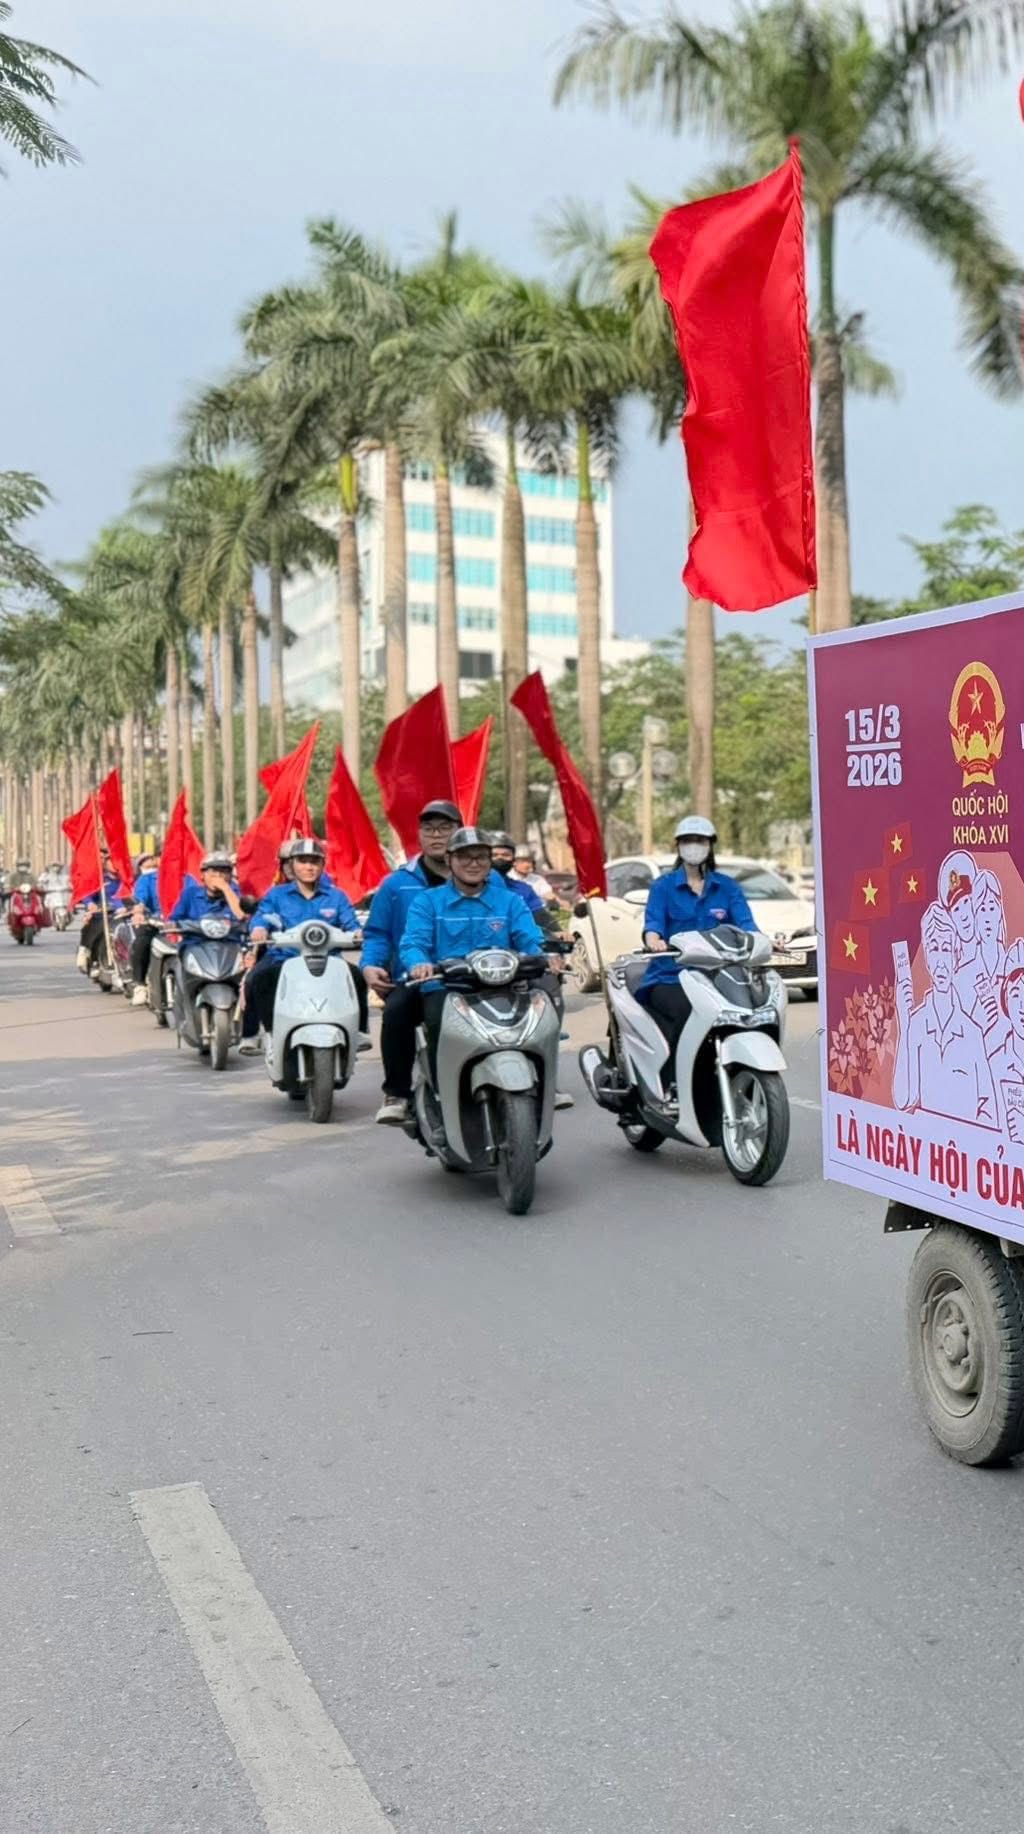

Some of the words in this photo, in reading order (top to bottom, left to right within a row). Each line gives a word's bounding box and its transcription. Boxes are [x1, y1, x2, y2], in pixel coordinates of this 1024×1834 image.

[845, 703, 901, 743] 15/3
[847, 753, 902, 787] 2026
[952, 789, 985, 816] QUỐC
[987, 790, 1009, 817] HỘI
[953, 822, 987, 845] KHÓA
[988, 825, 1009, 845] XVI
[837, 1109, 859, 1155] LÀ
[866, 1123, 922, 1176] NGÀY
[929, 1139, 968, 1198] HỘI
